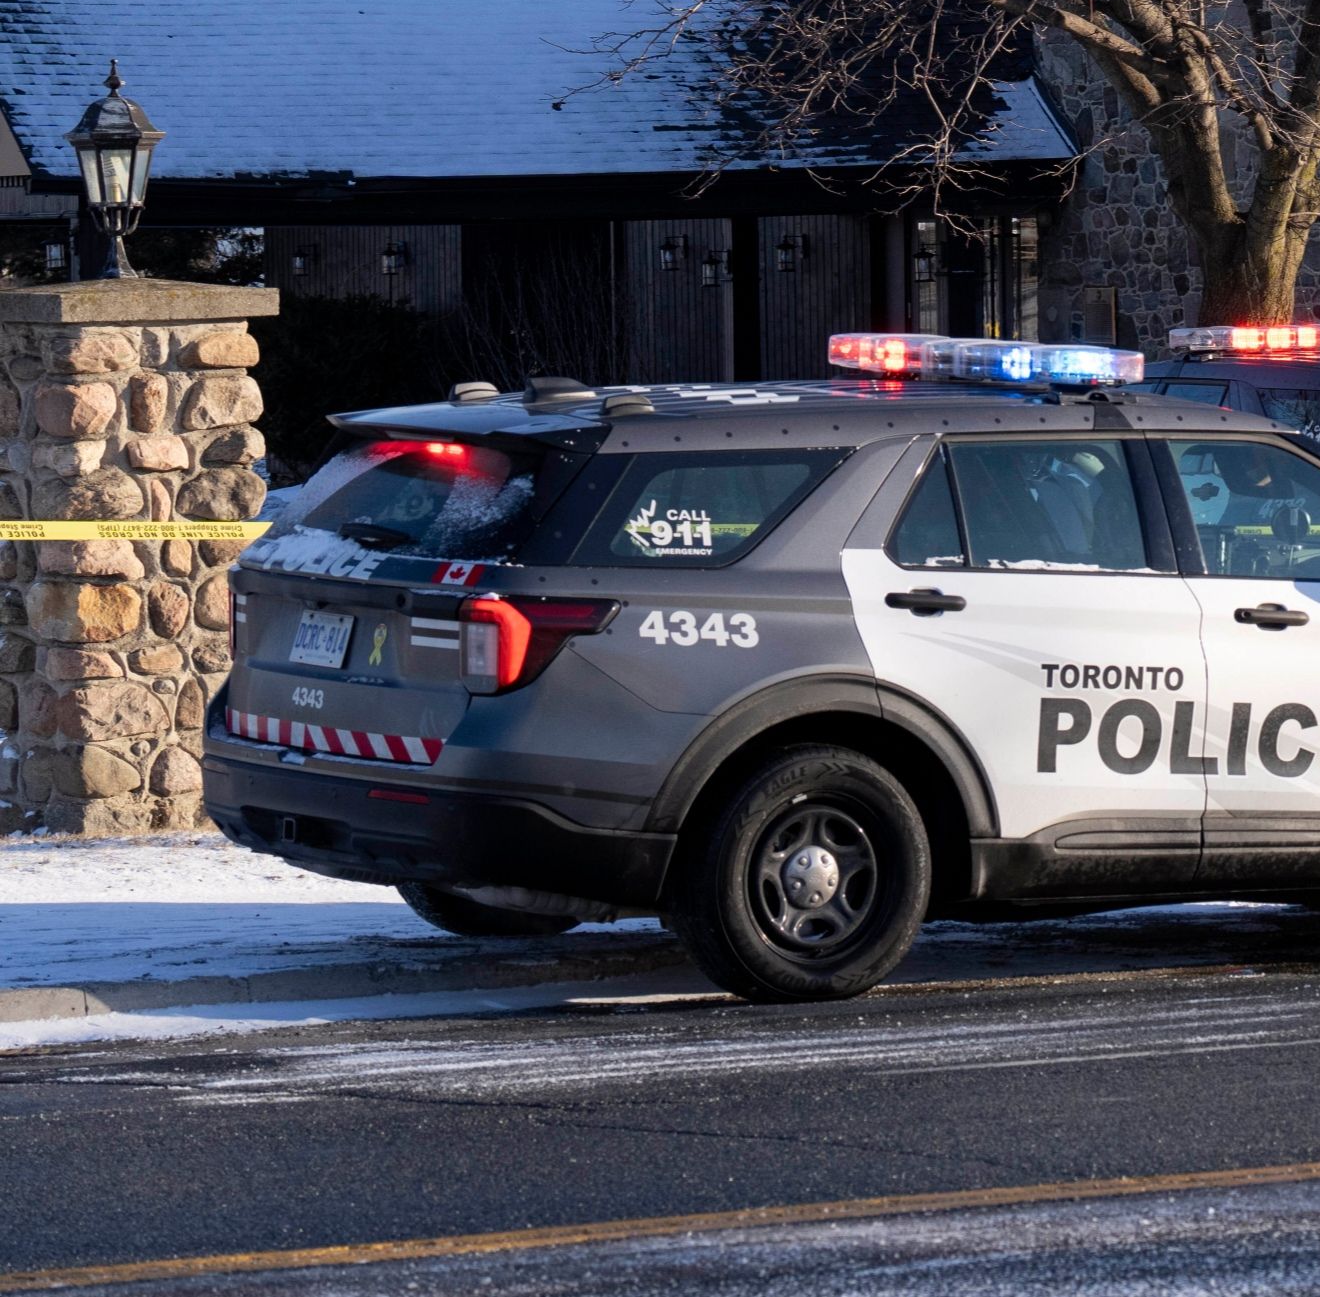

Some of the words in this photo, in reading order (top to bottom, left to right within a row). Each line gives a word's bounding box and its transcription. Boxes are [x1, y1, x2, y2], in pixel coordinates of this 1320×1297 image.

[666, 509, 711, 521] CALL
[639, 610, 759, 648] 4343
[1041, 664, 1184, 691] TORONTO
[292, 687, 324, 709] 4343
